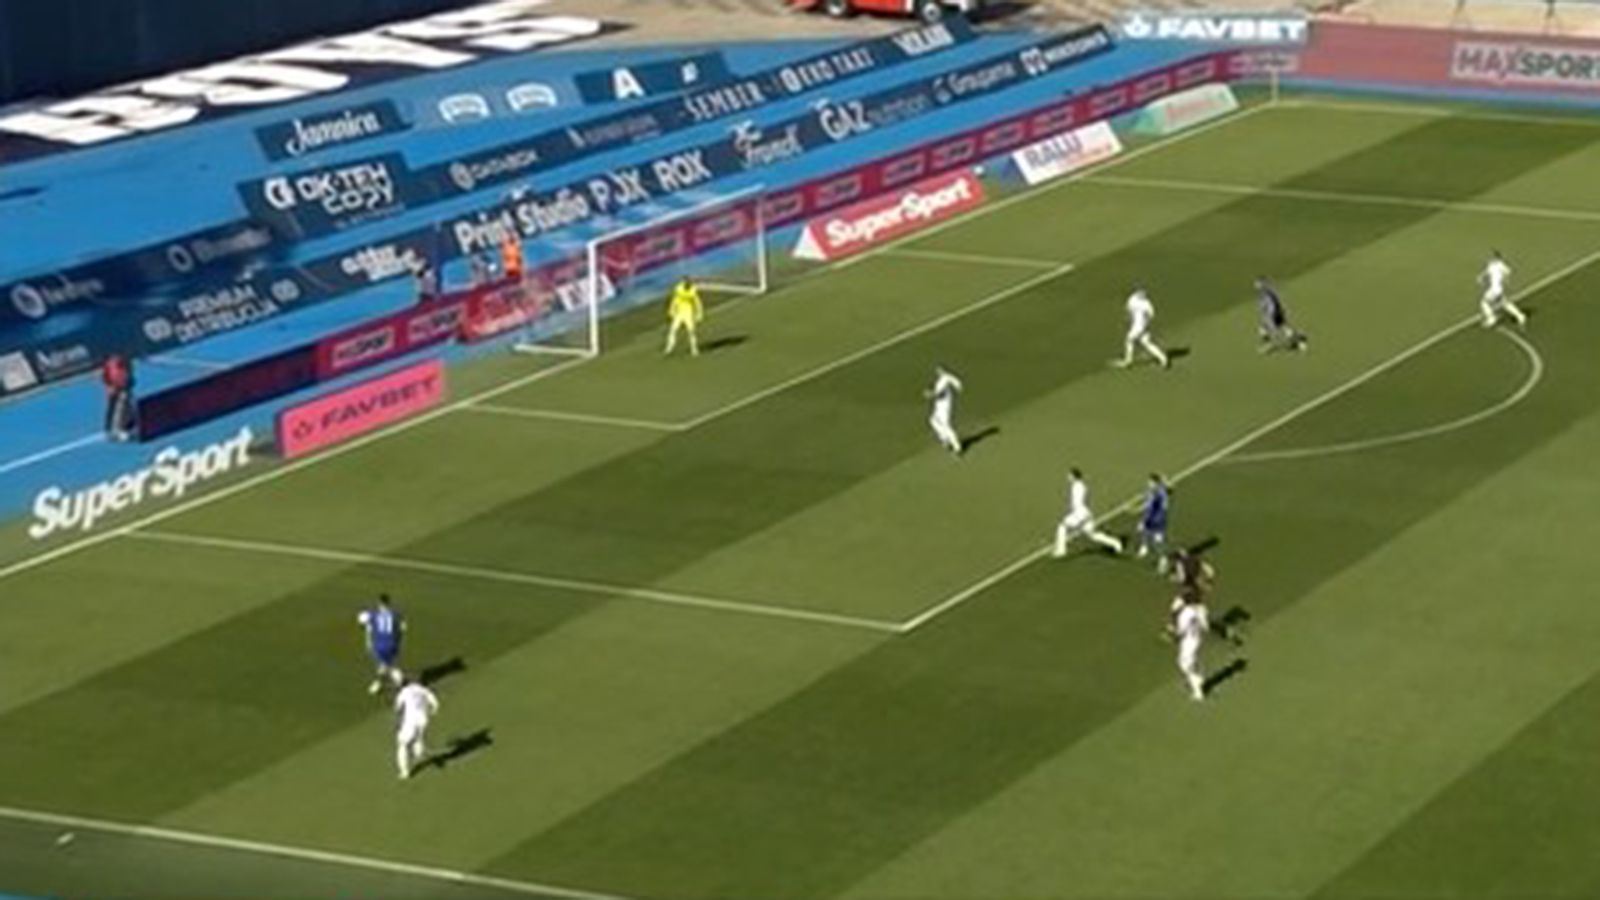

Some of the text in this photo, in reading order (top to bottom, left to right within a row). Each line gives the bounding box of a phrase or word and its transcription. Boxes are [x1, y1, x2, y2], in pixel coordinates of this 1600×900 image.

[1156, 18, 1306, 40] FAVBET
[1458, 48, 1600, 79] MAXSPOR
[613, 68, 645, 98] A
[825, 177, 973, 247] SuperSport
[28, 426, 253, 538] SuperSport
